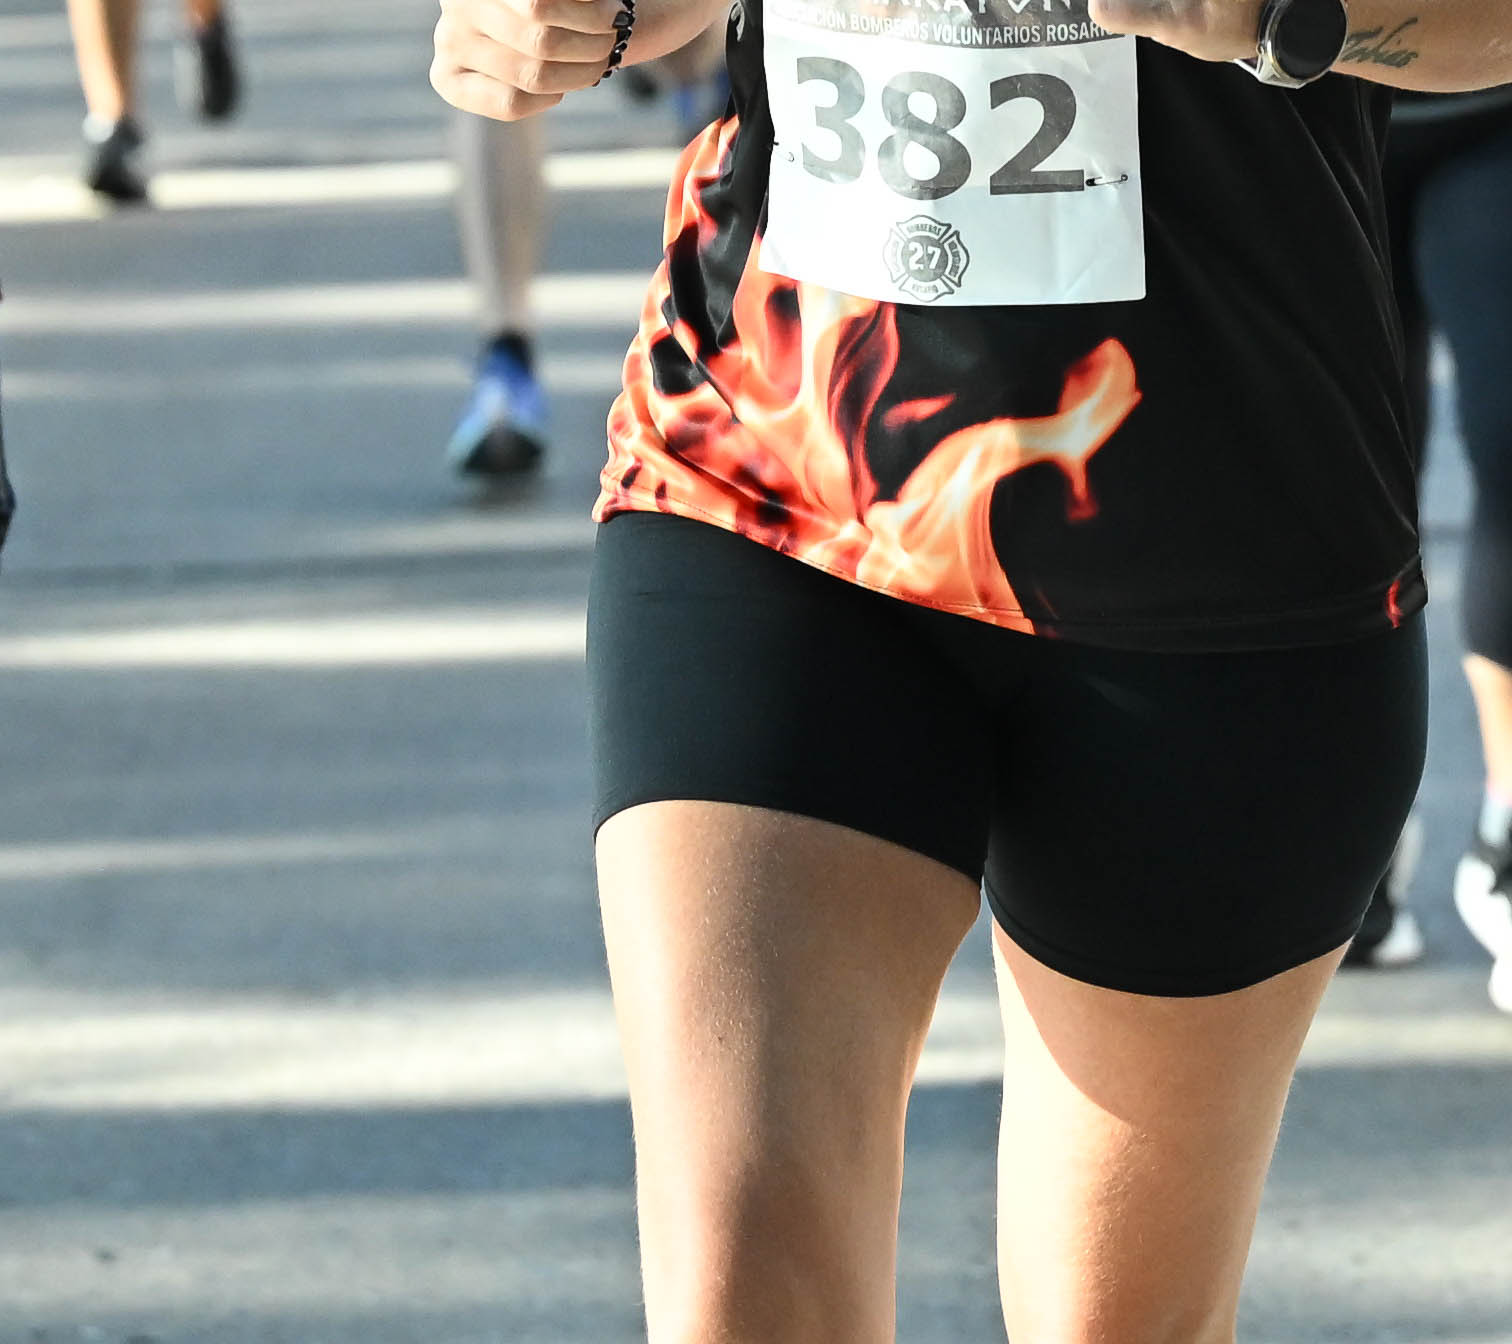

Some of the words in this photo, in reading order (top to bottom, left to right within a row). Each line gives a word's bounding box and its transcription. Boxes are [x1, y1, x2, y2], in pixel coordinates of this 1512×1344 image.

[850, 14, 929, 41] BOMBEROS
[933, 22, 1041, 46] VOLUNTARIOS
[796, 55, 1085, 201] 382
[908, 241, 942, 271] 27
